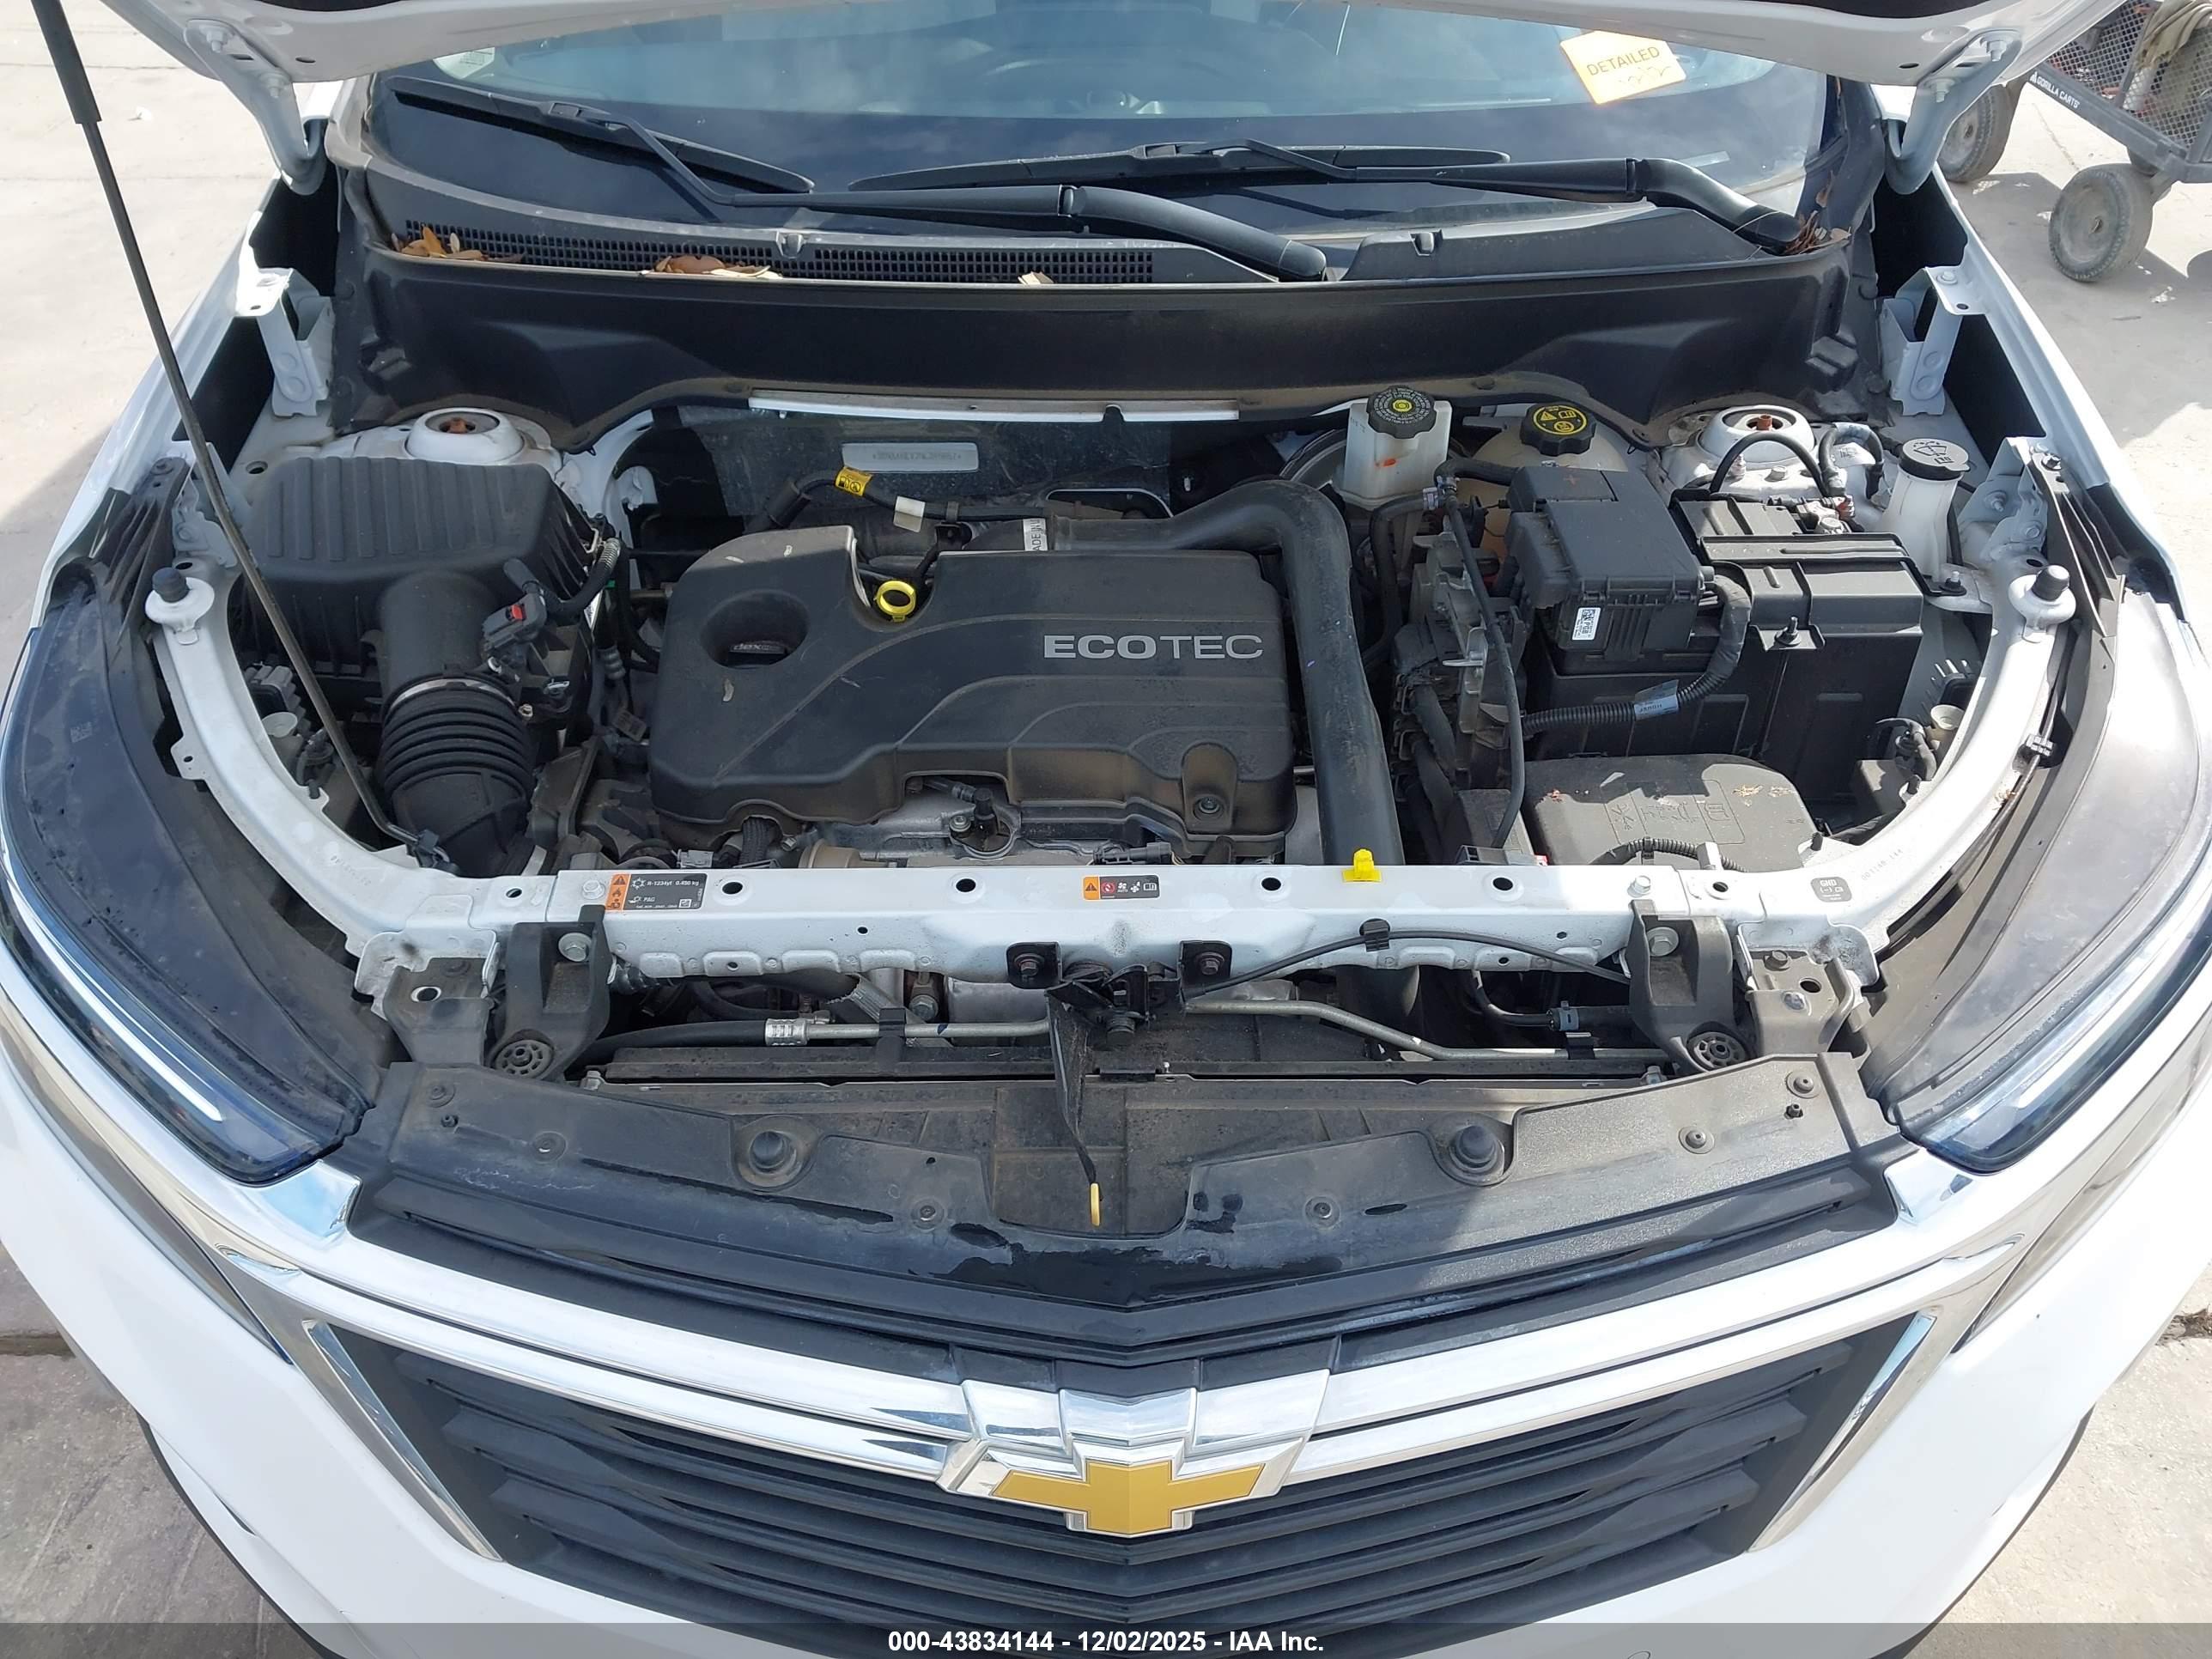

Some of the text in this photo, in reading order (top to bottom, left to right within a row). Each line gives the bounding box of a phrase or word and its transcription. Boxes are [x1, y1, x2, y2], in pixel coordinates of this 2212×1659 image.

[1586, 46, 1661, 76] DETAILED
[2036, 76, 2059, 96] GORILLA
[1044, 635, 1263, 659] ECOTEC
